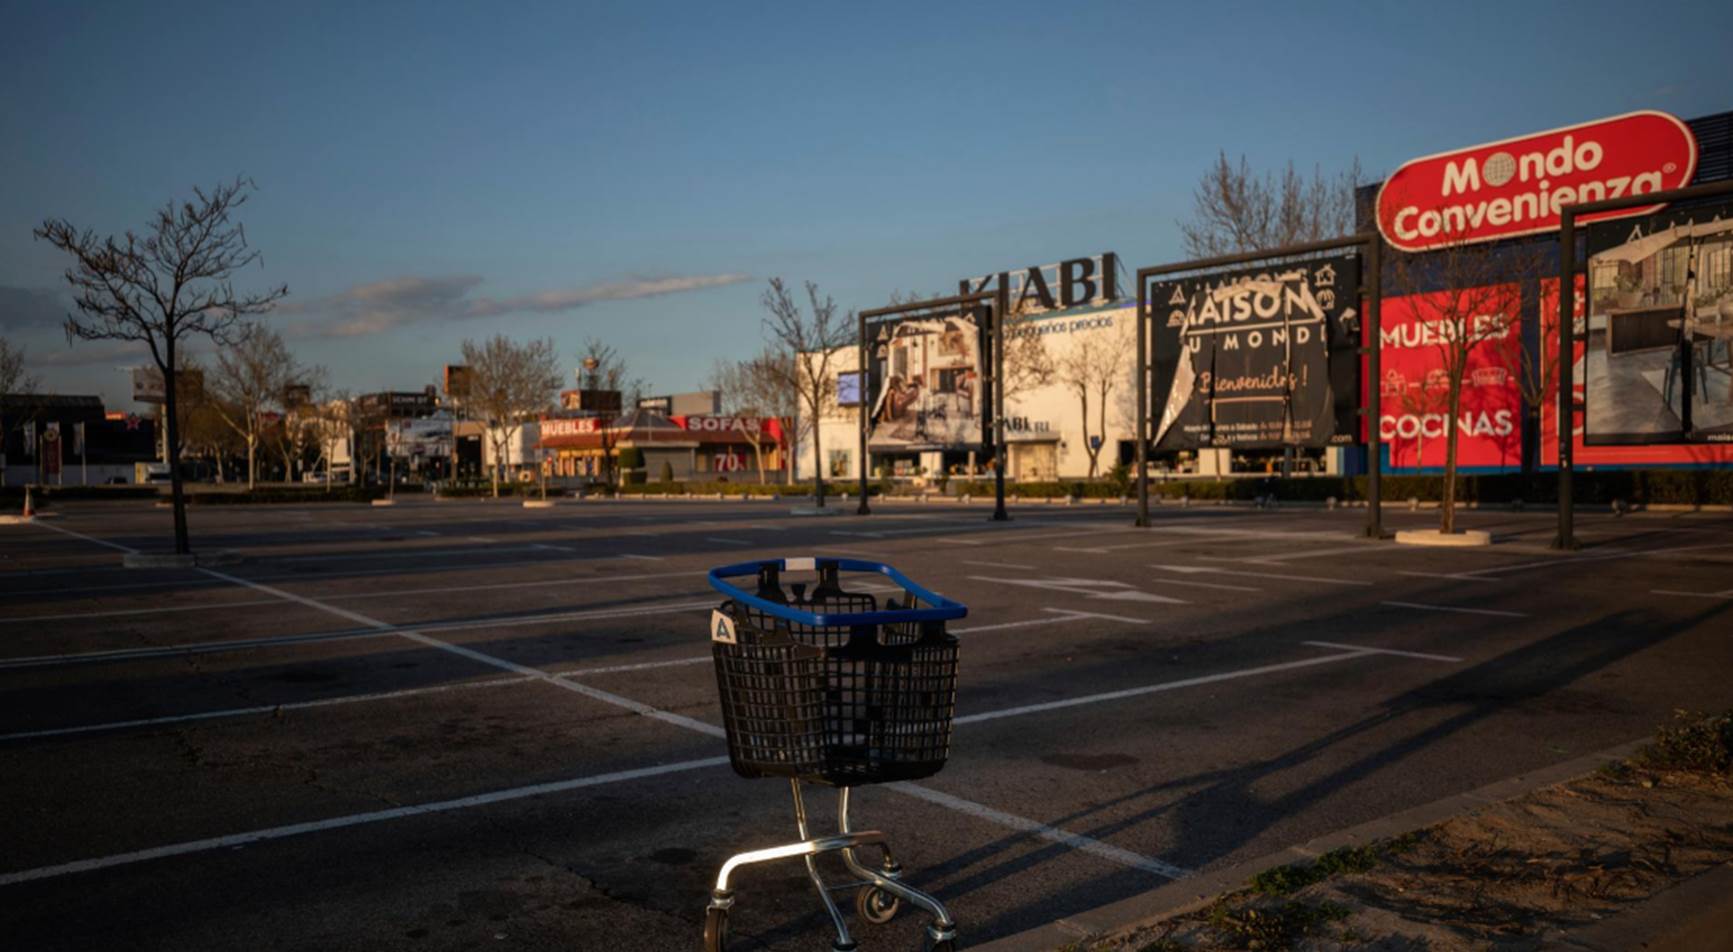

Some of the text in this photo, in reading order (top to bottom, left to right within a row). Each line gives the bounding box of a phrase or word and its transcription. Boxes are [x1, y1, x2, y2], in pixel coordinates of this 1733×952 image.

[1394, 171, 1663, 241] Convenienza
[1070, 314, 1114, 333] precios
[1380, 312, 1509, 349] MUEBLES
[541, 418, 595, 435] MUEBLES
[1380, 408, 1514, 440] COCINAS
[716, 618, 731, 640] A
